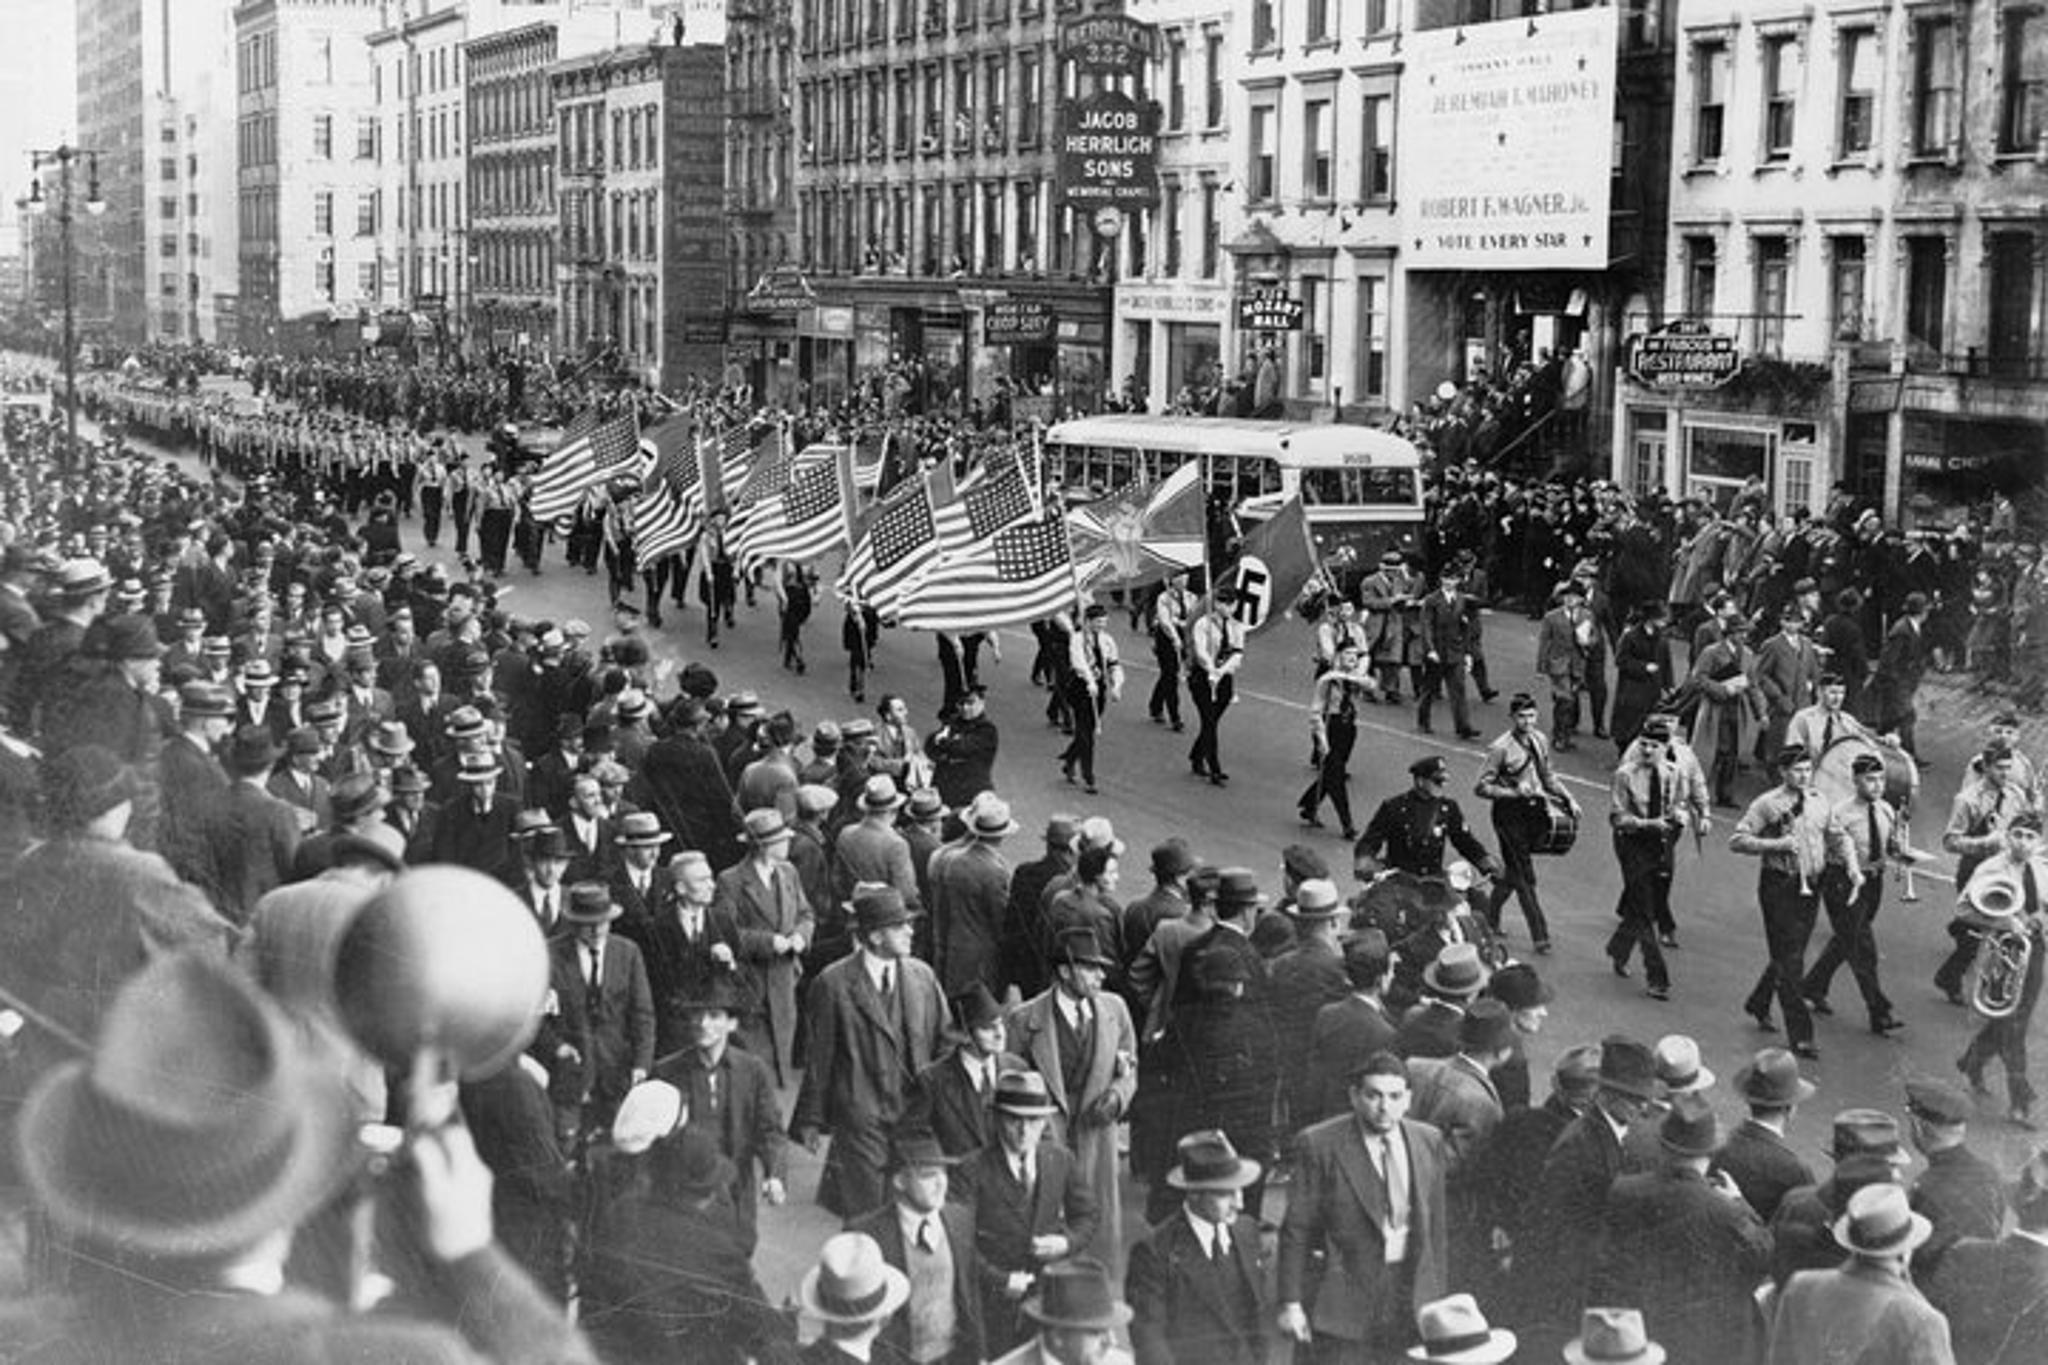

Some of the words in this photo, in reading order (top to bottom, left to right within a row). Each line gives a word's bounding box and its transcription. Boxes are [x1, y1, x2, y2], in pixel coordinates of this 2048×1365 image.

[1433, 89, 1509, 115] JEREMIAH
[1527, 79, 1600, 105] MAHONEY
[1078, 111, 1140, 130] JACOB
[1066, 135, 1154, 155] HERRLICH
[1084, 159, 1135, 178] SONS
[1420, 197, 1478, 219] ROBERT
[1436, 234, 1474, 251] VOTE
[1480, 233, 1529, 250] EVERY
[1534, 231, 1568, 248] STAR
[1242, 299, 1302, 317] MOZART
[1253, 315, 1290, 328] HALL
[1637, 351, 1735, 371] RESTAURANT
